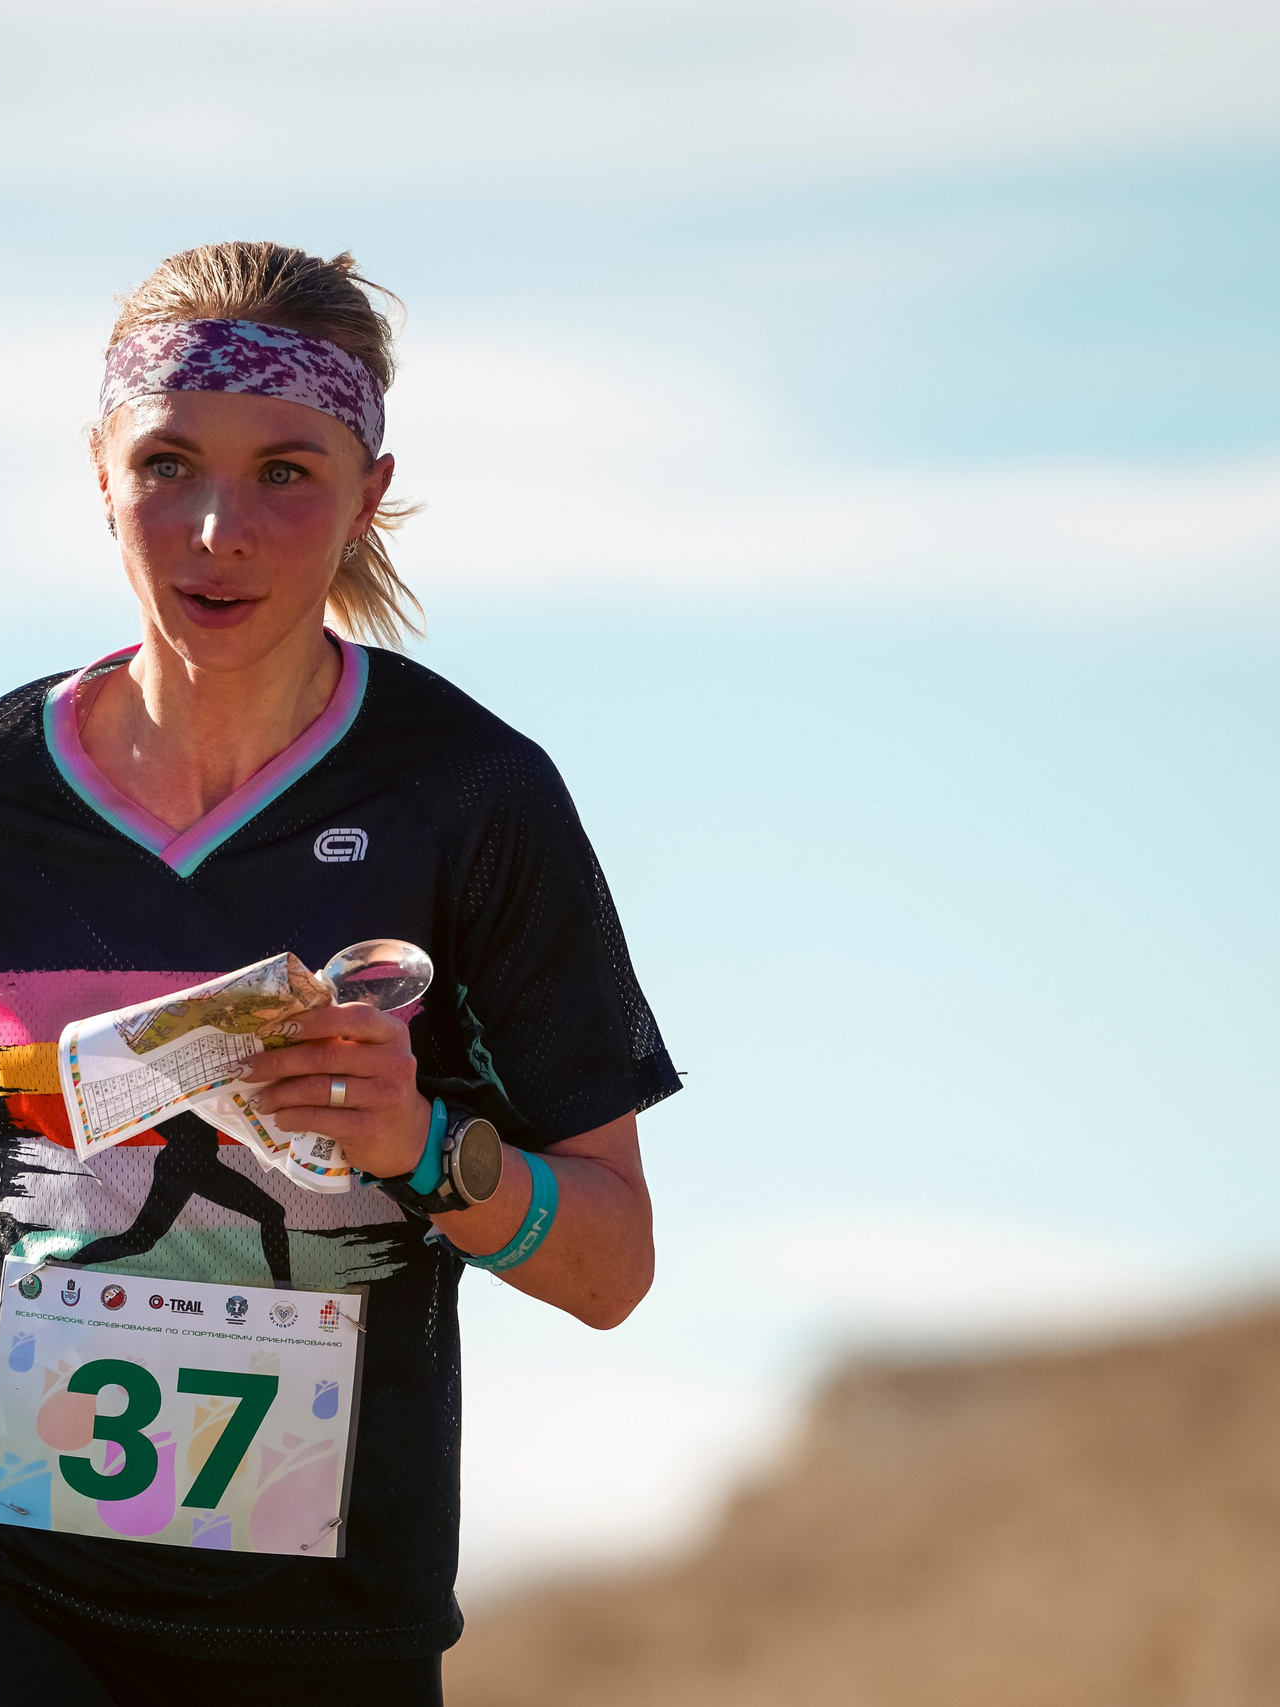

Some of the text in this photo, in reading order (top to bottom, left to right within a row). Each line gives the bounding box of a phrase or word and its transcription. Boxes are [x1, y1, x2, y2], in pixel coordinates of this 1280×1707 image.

[149, 1294, 204, 1313] O-TRAIL
[15, 1310, 342, 1348] ВСЕРОССИЙСКИЕ СОРЕВНОВАНИЯ ПО СПОРТИВНОМУ ОРИЕНТИРОВАНИЮ
[59, 1358, 279, 1510] 37
